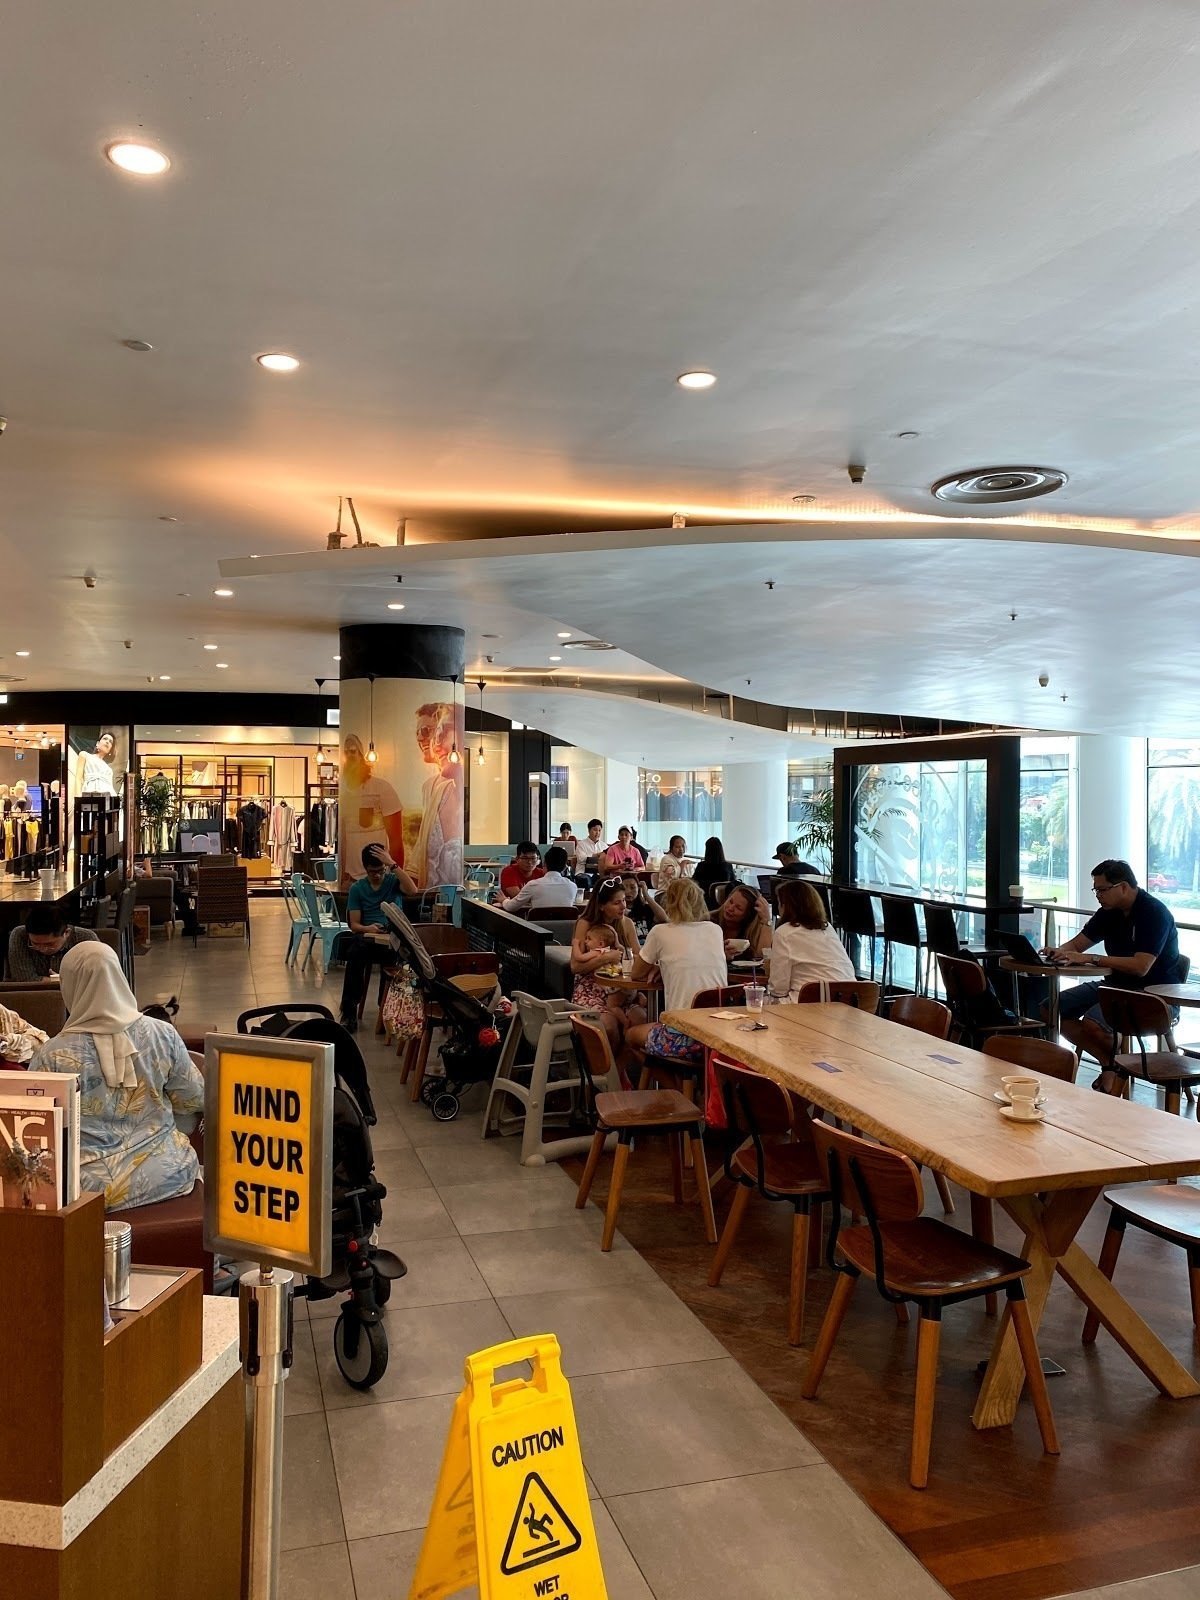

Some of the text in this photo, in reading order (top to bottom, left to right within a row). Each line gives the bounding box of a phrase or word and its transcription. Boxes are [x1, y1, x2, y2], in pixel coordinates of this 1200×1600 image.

[233, 1083, 301, 1124] MIND
[231, 1130, 304, 1175] YOUR
[233, 1180, 300, 1223] STEP
[491, 1425, 564, 1468] CAUTION
[533, 1574, 560, 1598] WET
